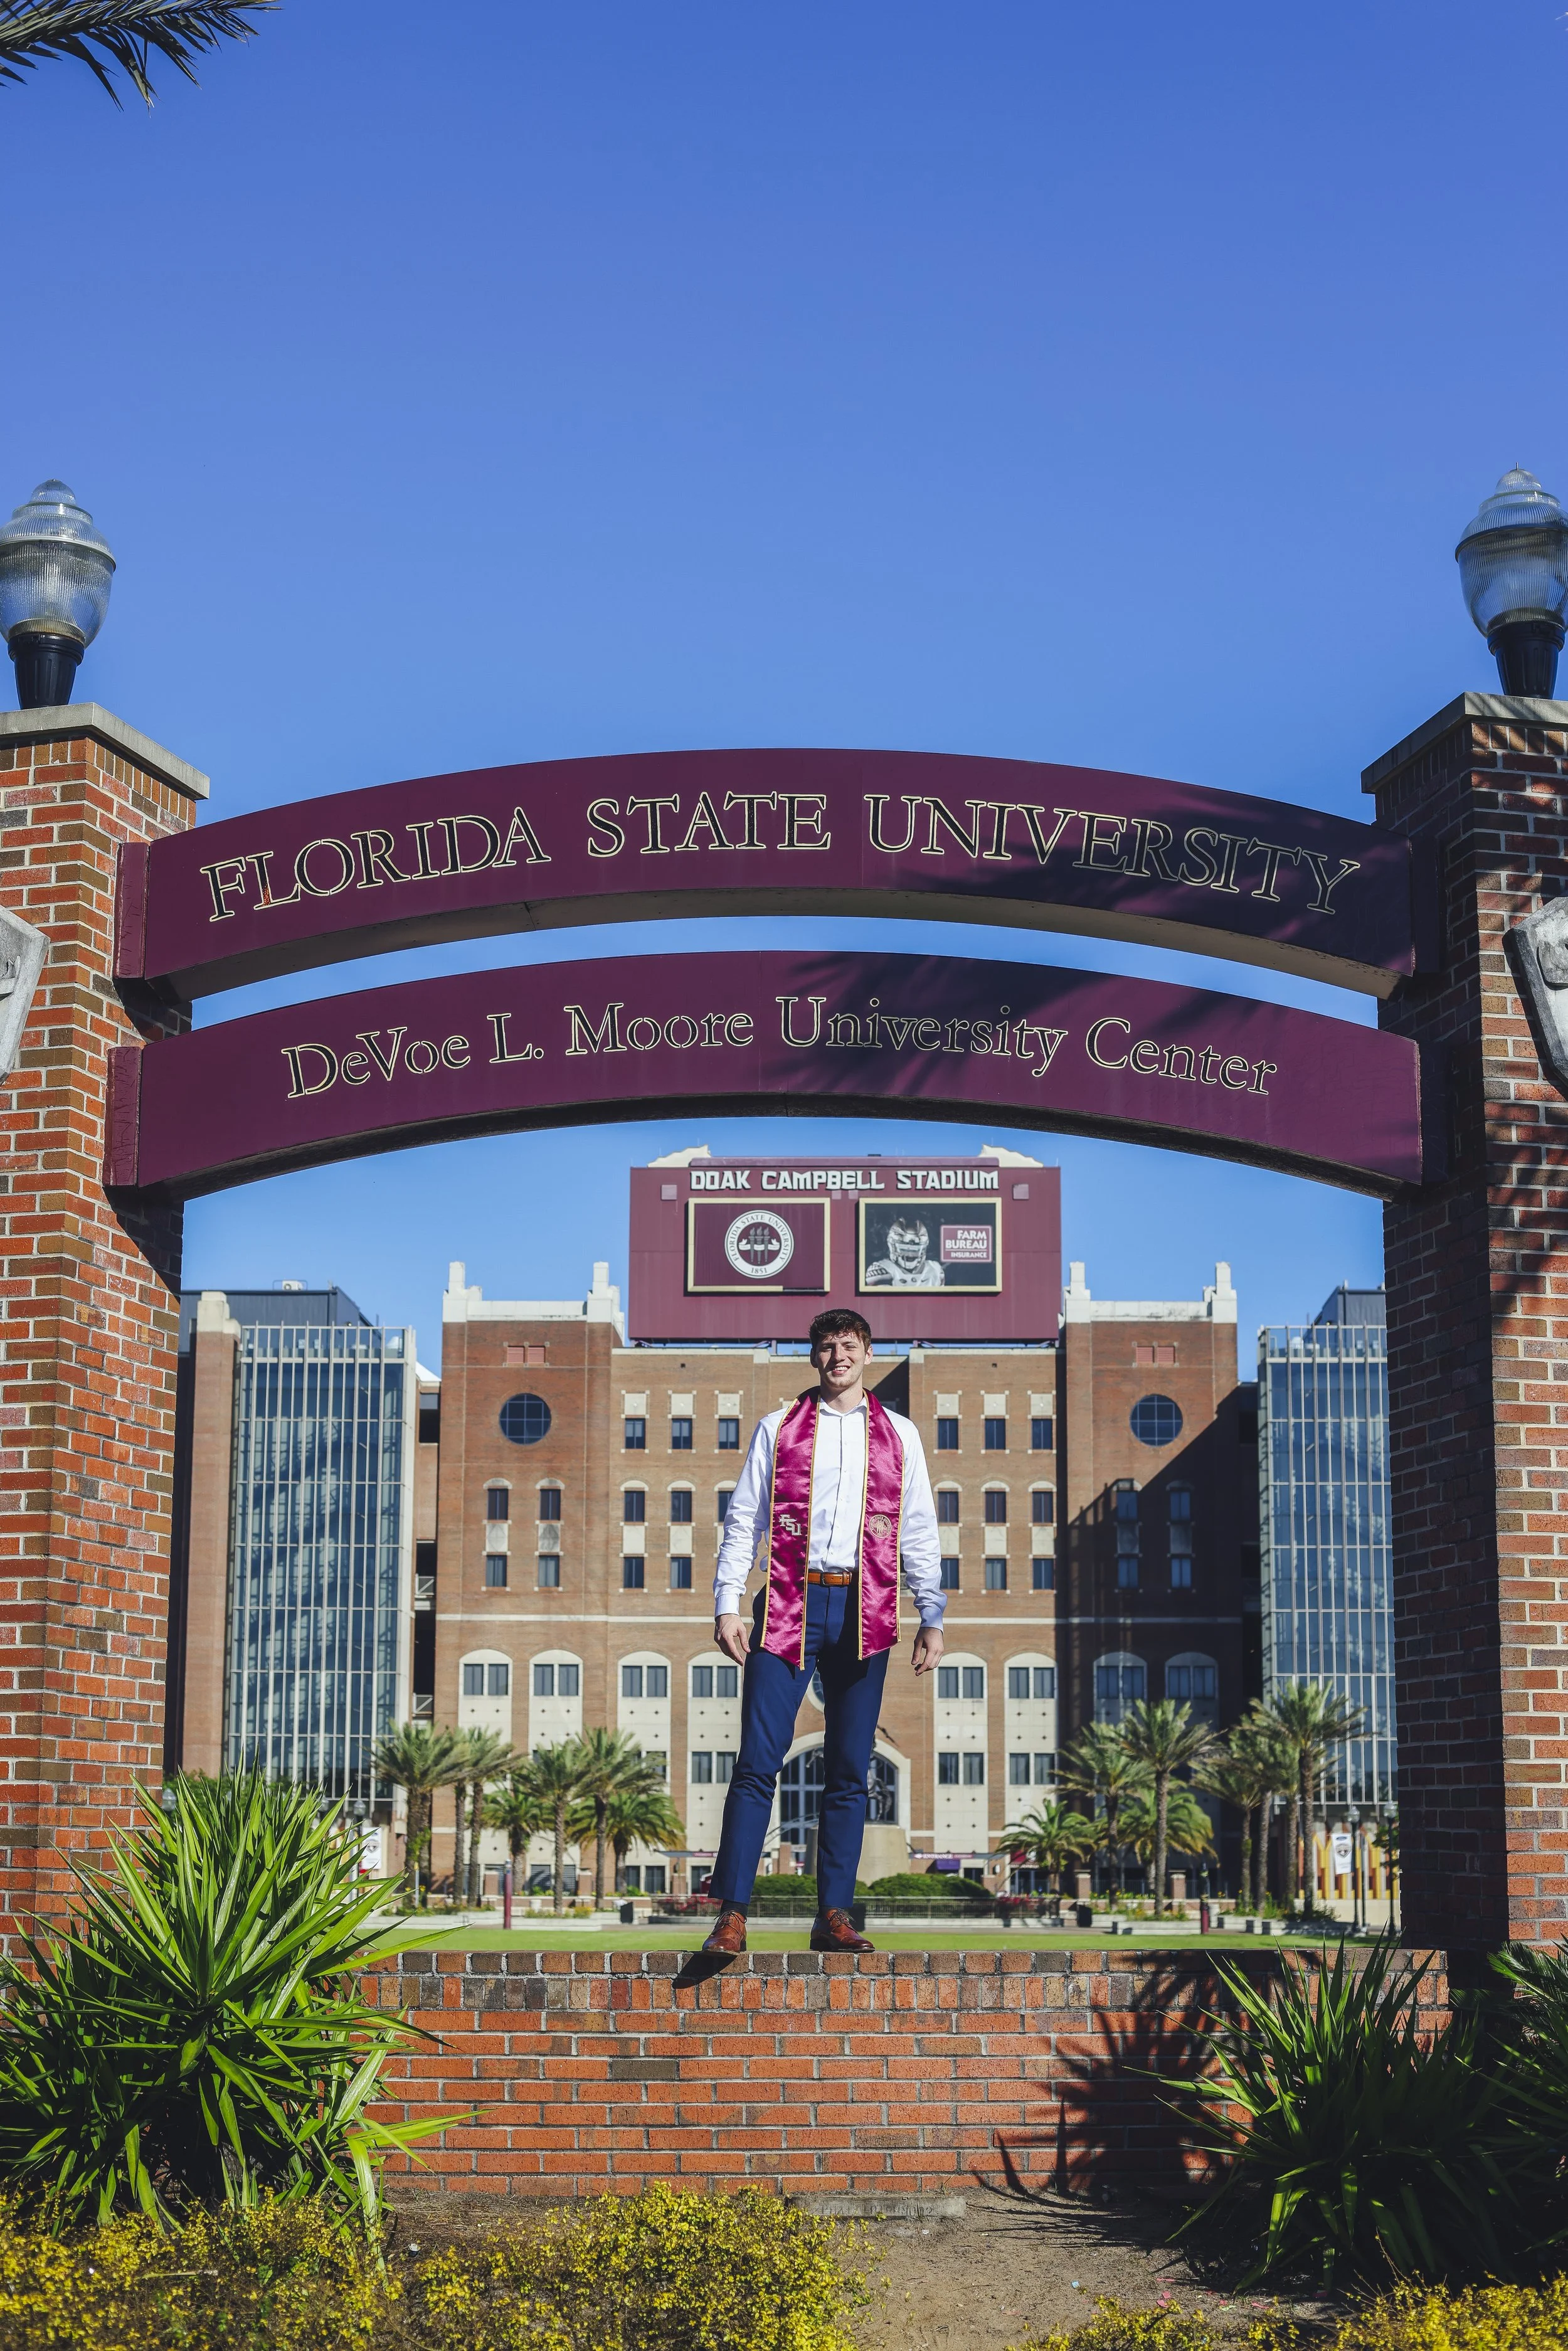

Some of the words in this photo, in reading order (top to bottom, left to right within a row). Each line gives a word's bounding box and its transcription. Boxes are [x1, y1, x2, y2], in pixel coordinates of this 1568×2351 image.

[199, 806, 552, 922] FLORIDA
[586, 791, 832, 857] STATE
[863, 793, 1362, 915] UNIVERSITY
[280, 1026, 471, 1099] DeVoe
[487, 1012, 544, 1064] L.
[564, 1002, 754, 1056] Moore
[775, 995, 1068, 1078] University
[1084, 1017, 1277, 1096] Center
[691, 1170, 751, 1190] DOAK
[761, 1170, 885, 1190] CAMPBELL
[896, 1170, 999, 1190] STADIUM
[729, 1226, 741, 1261] FLORIDA
[741, 1214, 765, 1225] STATE
[768, 1216, 789, 1261] UNIVERSITY
[945, 1239, 987, 1249] BUREAU
[957, 1230, 987, 1239] FARM
[779, 1514, 802, 1536] FSU
